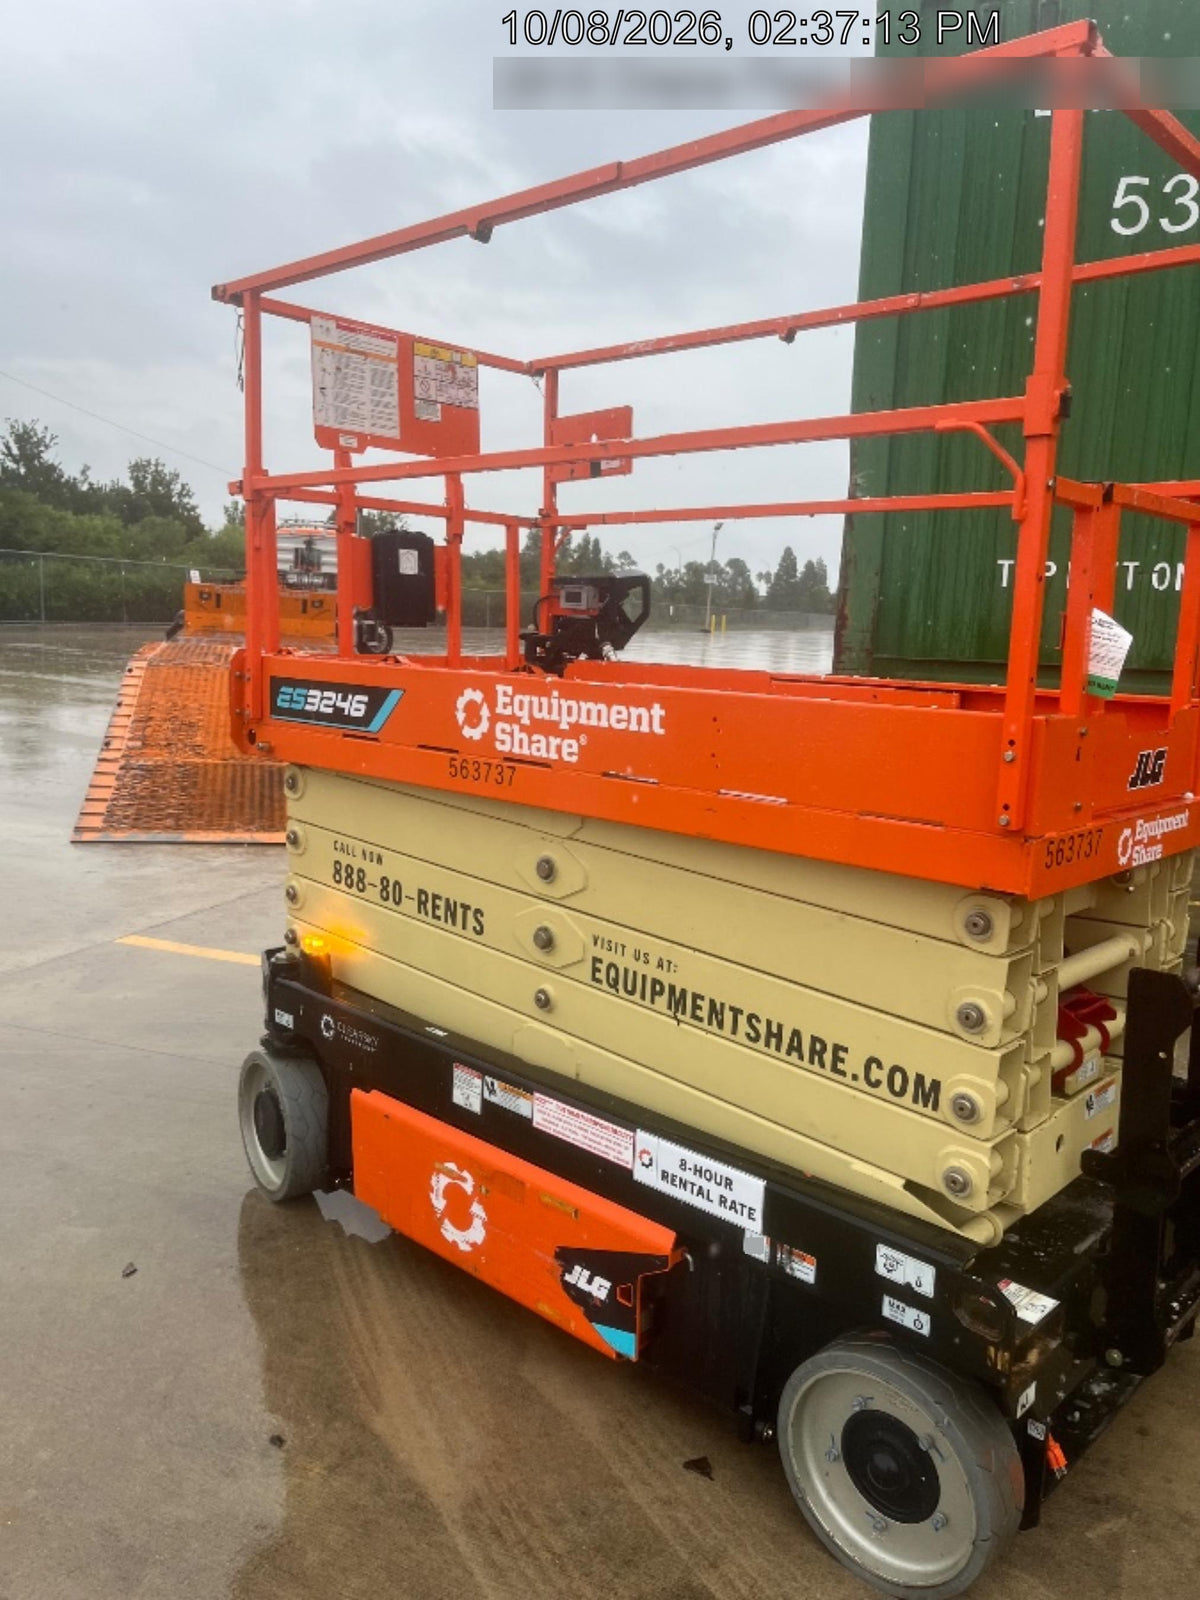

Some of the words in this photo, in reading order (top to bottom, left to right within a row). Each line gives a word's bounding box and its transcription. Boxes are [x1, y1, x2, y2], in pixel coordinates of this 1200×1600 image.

[277, 686, 369, 718] ES3246
[495, 684, 665, 735] Equipment
[448, 757, 516, 786] 563737
[1127, 746, 1168, 791] JLG
[1135, 808, 1189, 843] Equipment
[333, 840, 357, 858] CALL
[362, 848, 383, 866] NOW
[1045, 828, 1103, 869] 563737
[1132, 843, 1163, 866] Share
[333, 859, 484, 936] 888-80-RENTS
[592, 933, 627, 957] VISIT
[633, 948, 650, 965] US
[656, 955, 678, 973] AT:
[590, 955, 942, 1112] EQUIPMENTSHARE.COM
[679, 1158, 733, 1192] 8-HOUR
[660, 1169, 713, 1203] RENTAL
[719, 1194, 756, 1221] RATE
[564, 1265, 612, 1301] JLG
